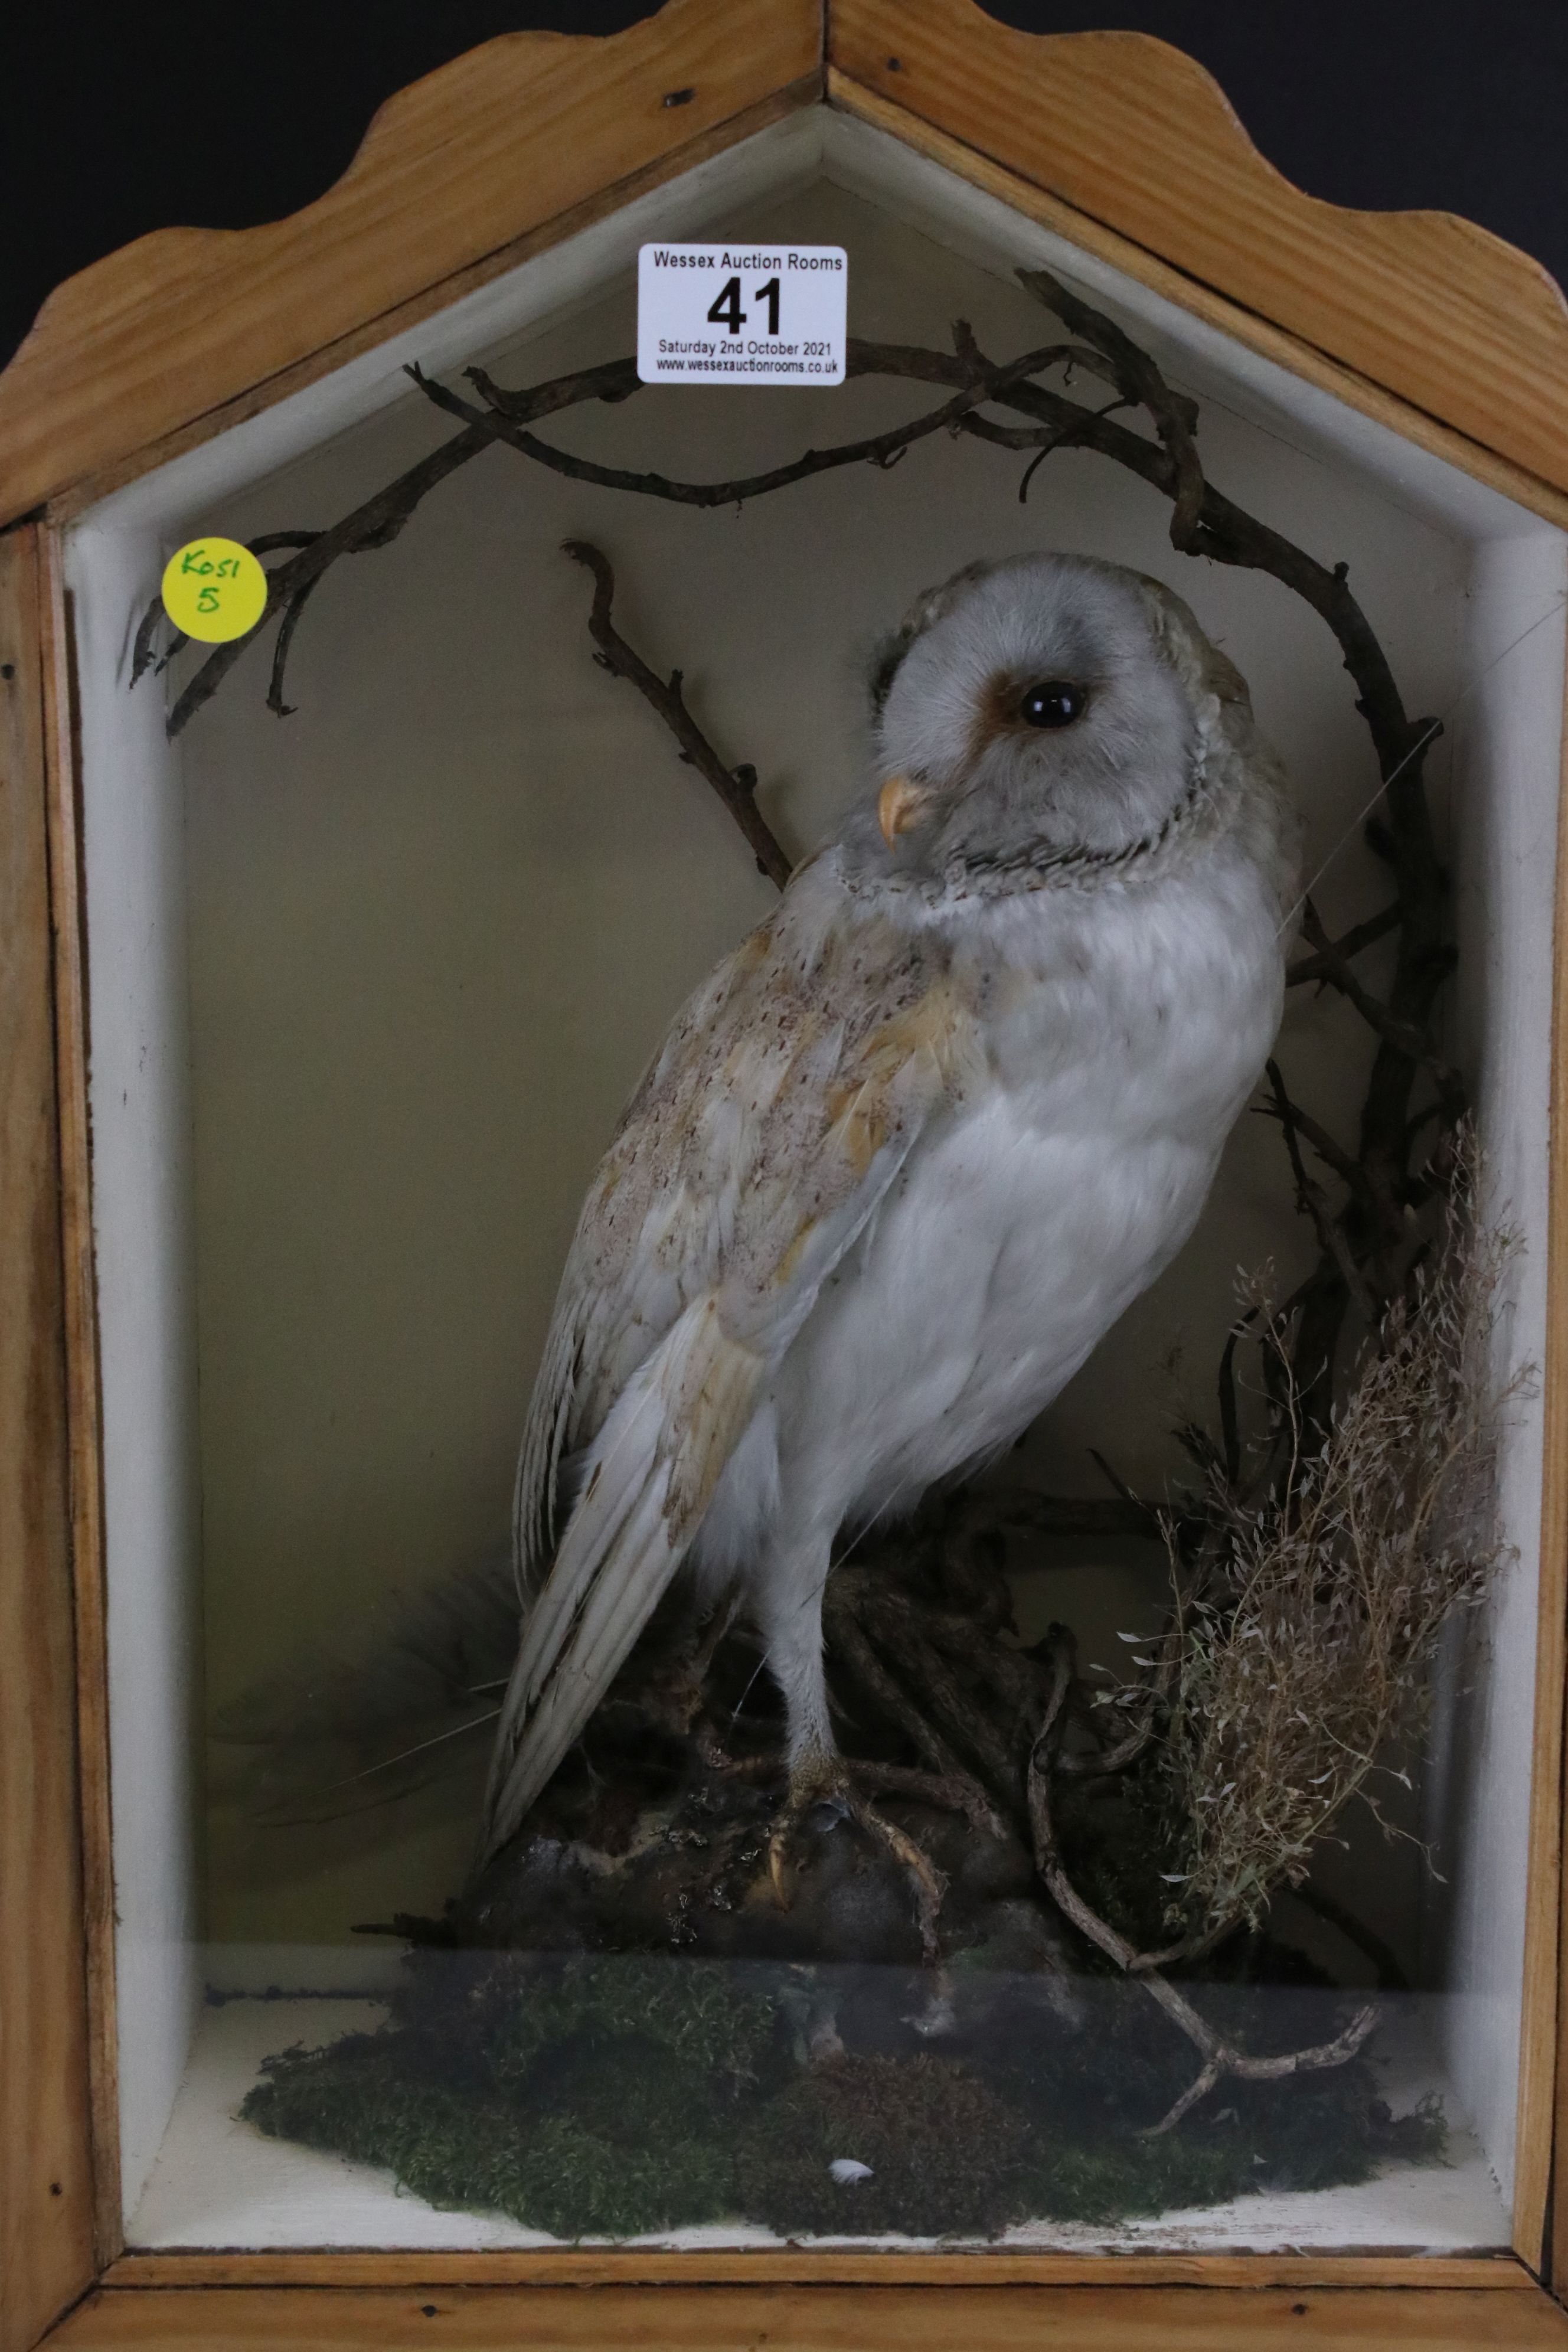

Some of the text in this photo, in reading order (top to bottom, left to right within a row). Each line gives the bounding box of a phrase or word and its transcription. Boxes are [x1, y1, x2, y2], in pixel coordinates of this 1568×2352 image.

[654, 251, 842, 270] Wessex Auction Rooms
[707, 276, 780, 335] 41
[659, 339, 831, 357] Saturday 2nd October 2021
[656, 358, 838, 374] www.wessexauctionrooms.co.uk
[197, 587, 220, 613] 5
